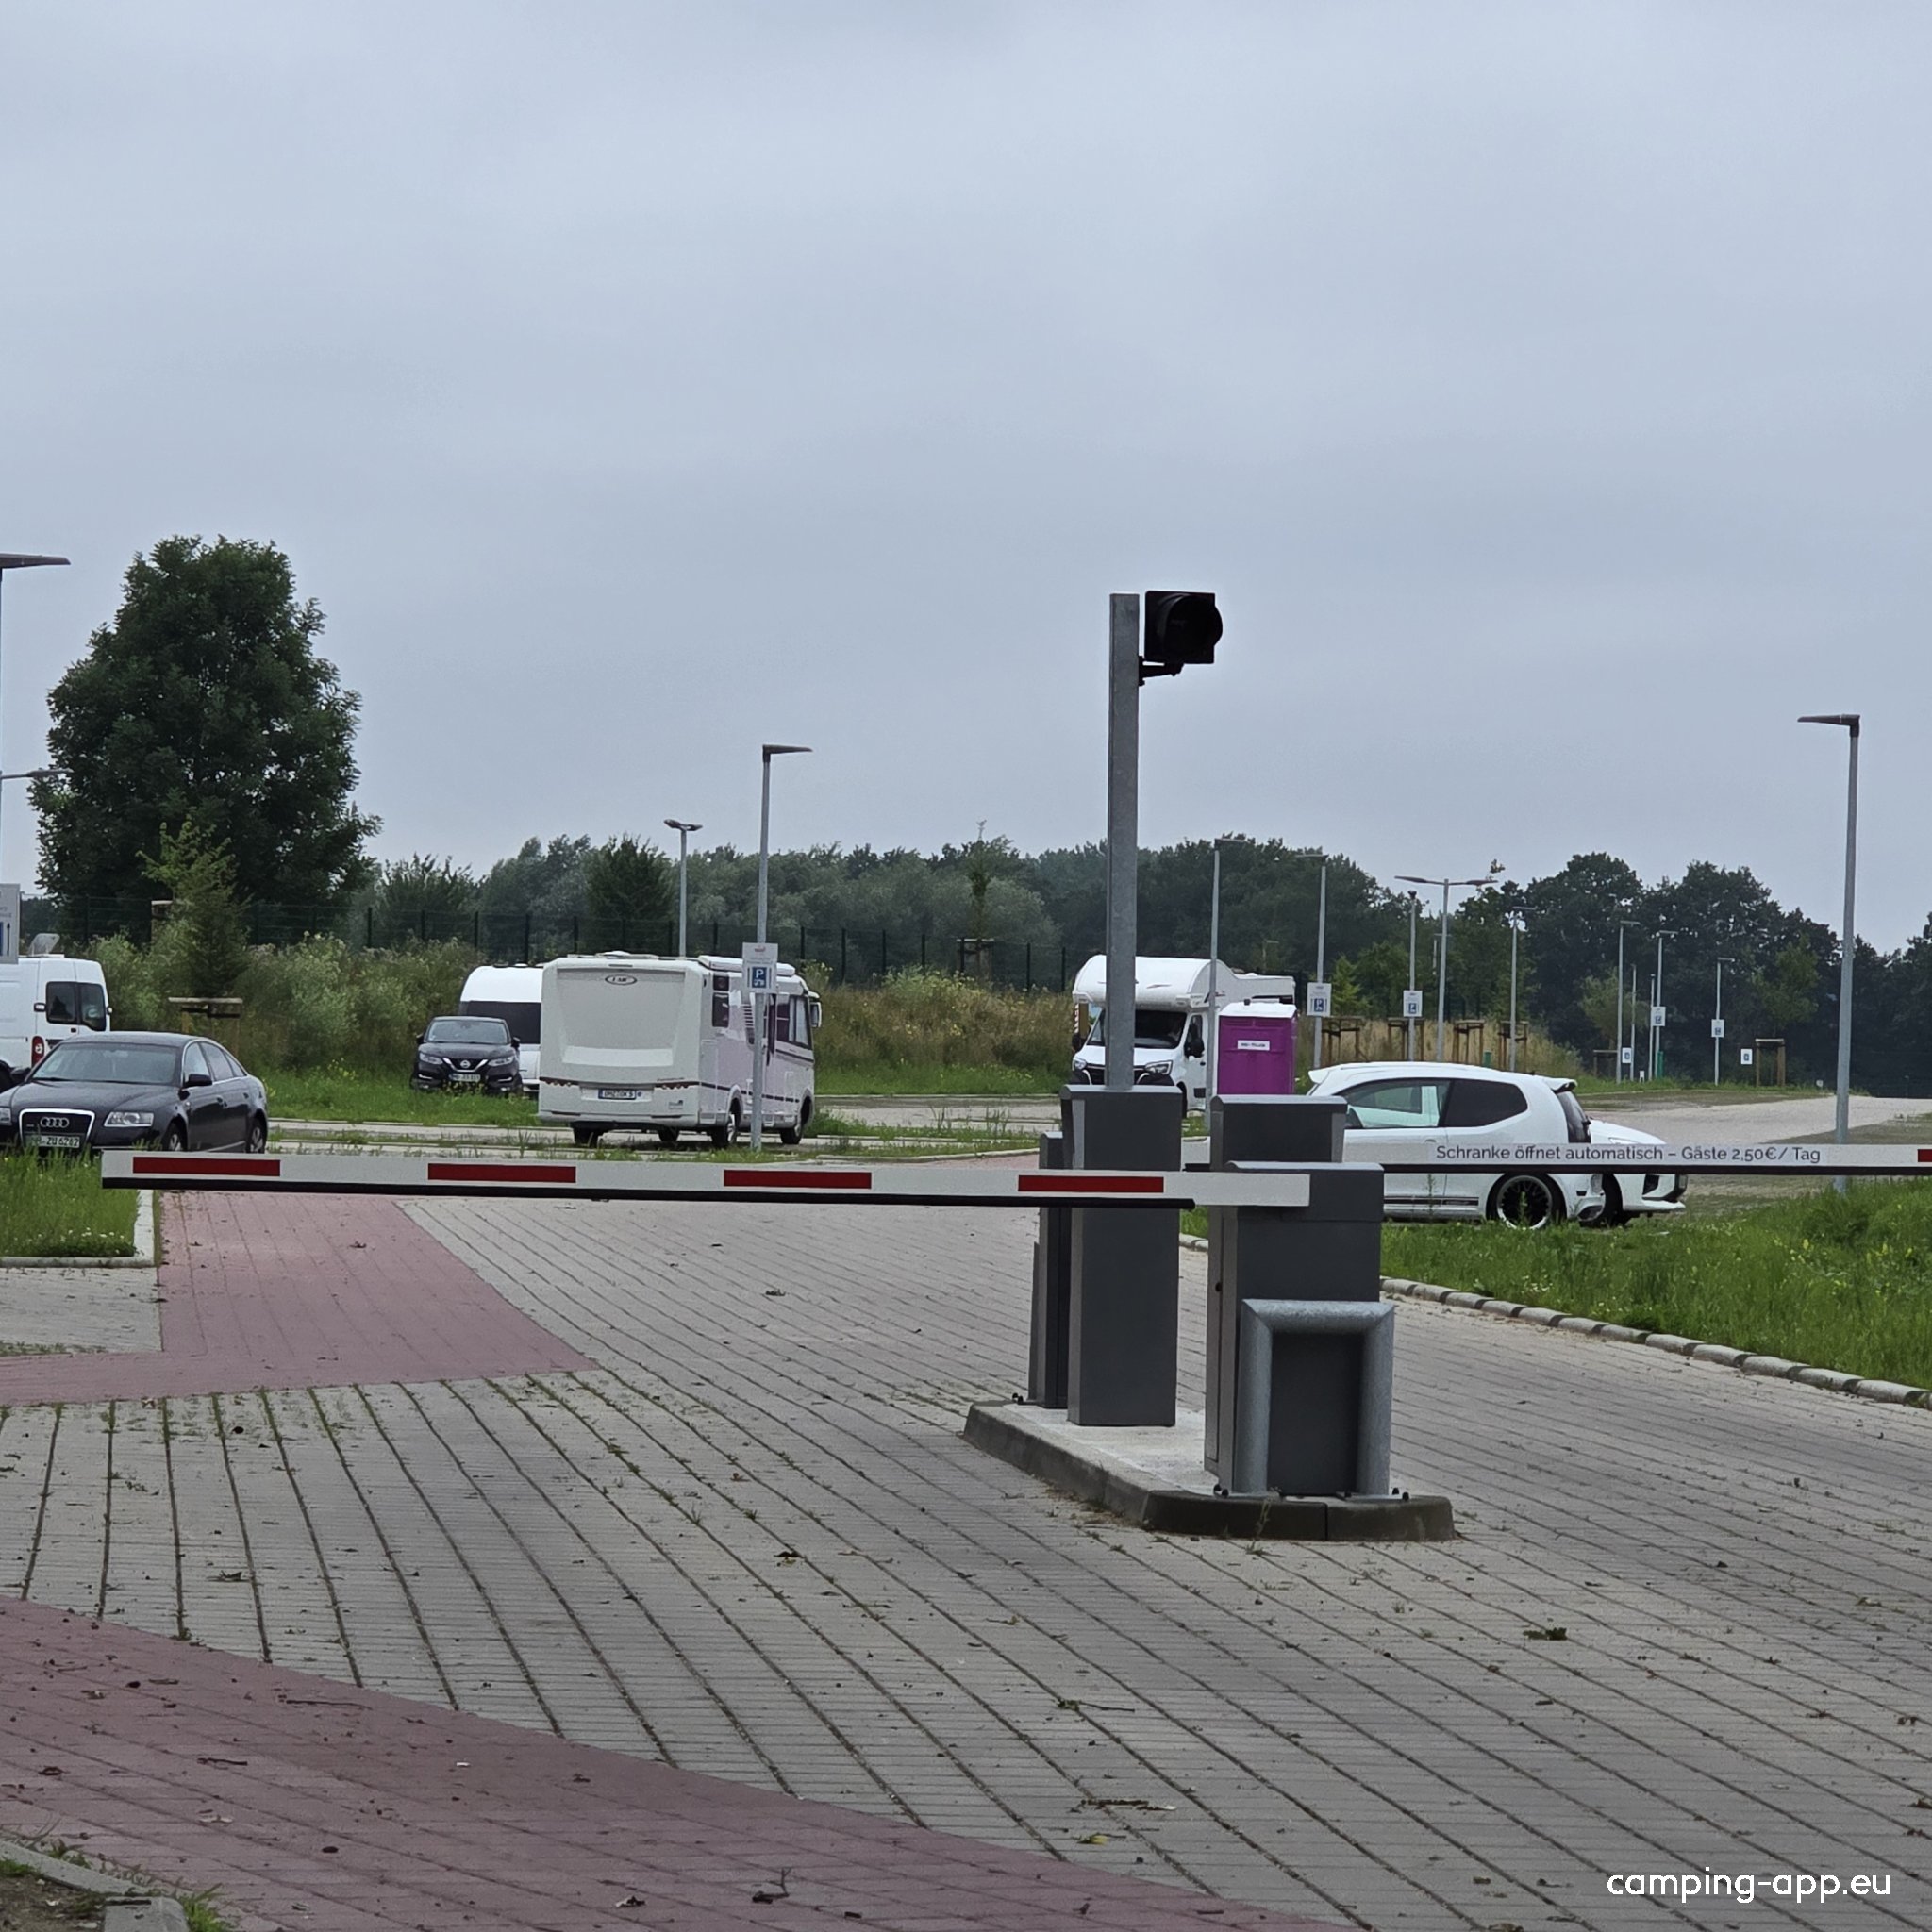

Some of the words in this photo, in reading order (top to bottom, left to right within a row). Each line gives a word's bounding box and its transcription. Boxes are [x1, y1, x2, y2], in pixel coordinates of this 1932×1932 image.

[1436, 1145, 1509, 1159] Schranke
[1515, 1145, 1561, 1159] öffnet
[1565, 1146, 1663, 1160] automatisch
[1681, 1146, 1727, 1160] Gäste
[1792, 1147, 1821, 1164] Tag
